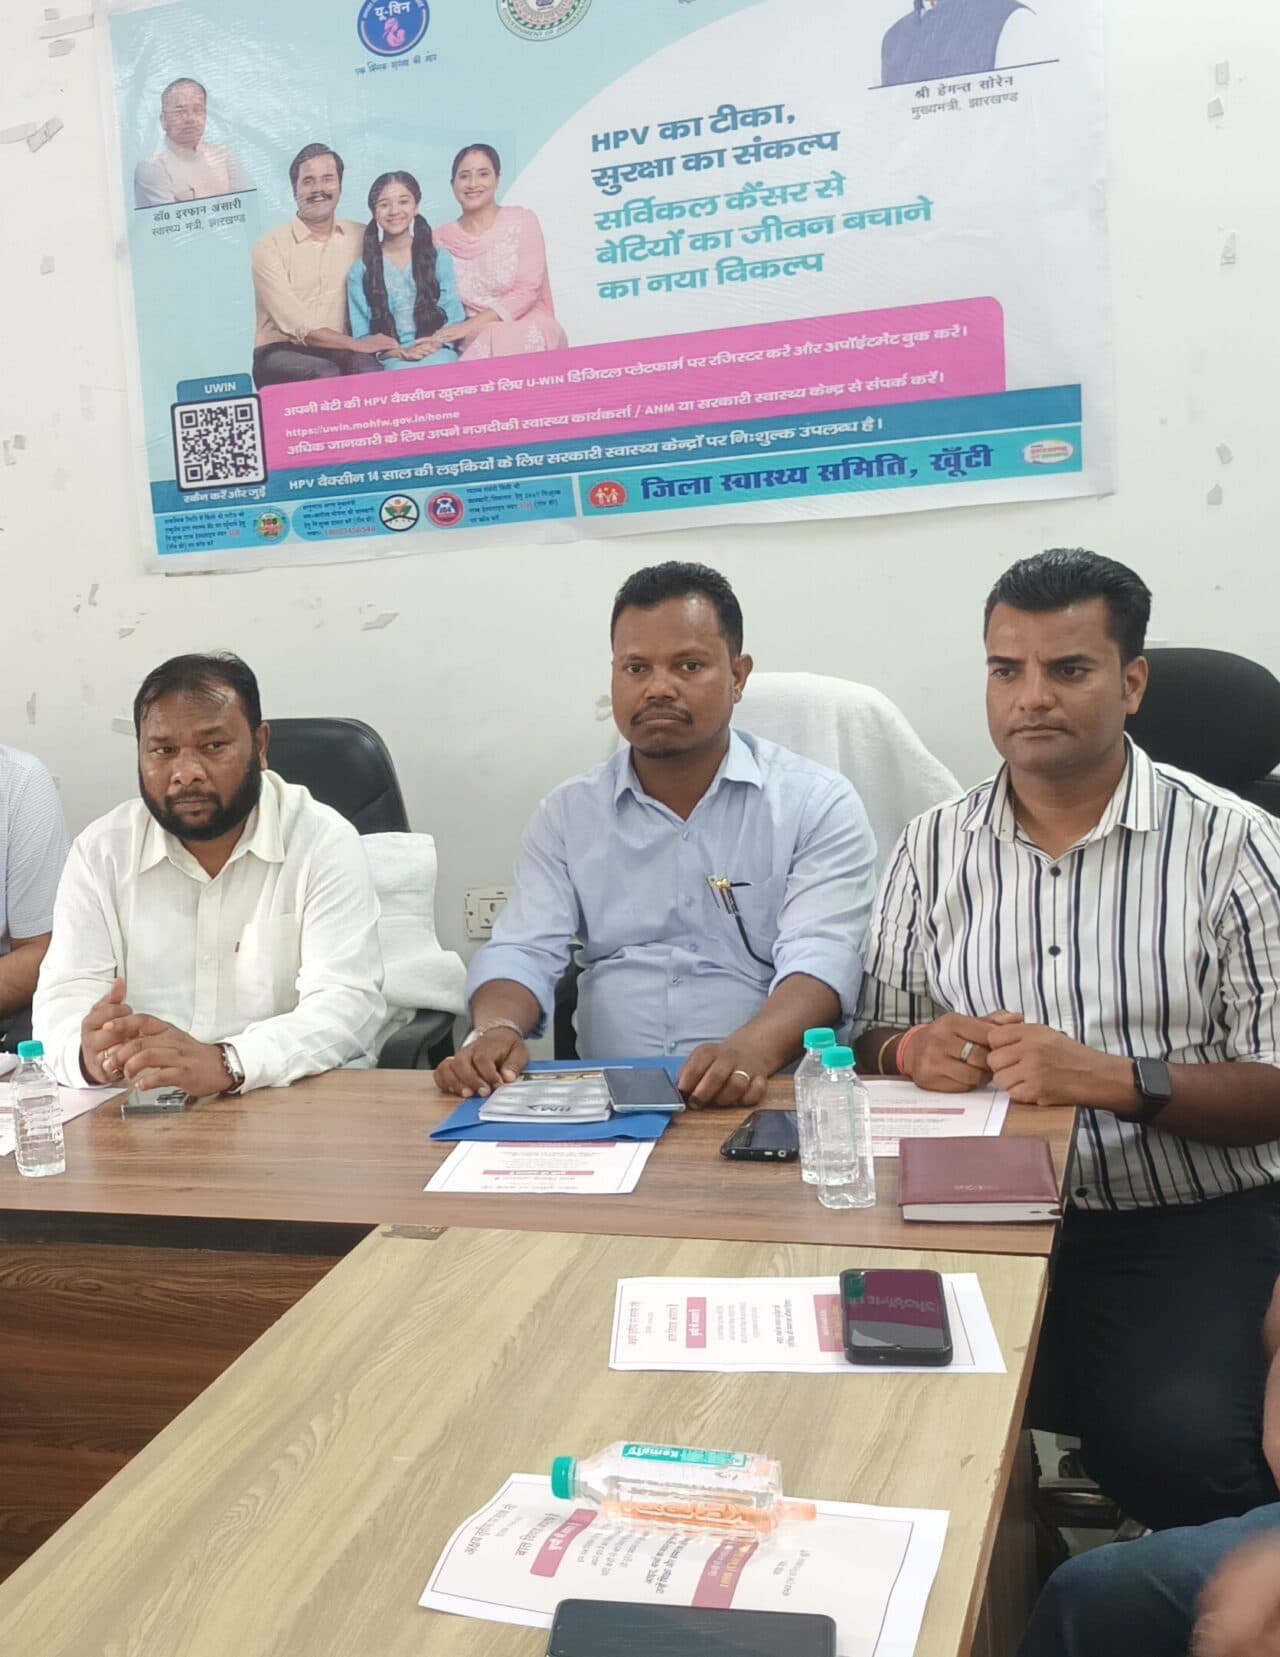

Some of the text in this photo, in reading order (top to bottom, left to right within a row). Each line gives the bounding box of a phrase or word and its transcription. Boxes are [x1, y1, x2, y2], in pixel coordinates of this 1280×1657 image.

[375, 1, 411, 21] यू-विन
[915, 75, 1013, 99] श्री हेमन्त सोरेन
[592, 103, 796, 152] HPV का टीका,
[591, 131, 840, 196] सुरक्षा का संकल्प
[594, 170, 846, 231] सर्विकल कैंसर से
[596, 195, 933, 265] बेटियों का जीवन बचाने
[597, 253, 824, 299] का नया विकल्प
[204, 382, 236, 395] UWIN
[284, 401, 318, 417] अपनी
[344, 396, 361, 409] की
[364, 396, 387, 407] HPV
[480, 378, 494, 393] के
[498, 379, 523, 391] लिए
[526, 375, 564, 388] U-WIN
[567, 367, 620, 383] डिजिटल
[687, 357, 706, 369] पर
[793, 341, 821, 356] और
[902, 330, 930, 348] बुक
[285, 410, 461, 439] https://uwin.mohfw.gov.in/home
[287, 441, 324, 456] अधिक
[327, 433, 382, 450] जानकारी
[384, 431, 398, 444] के
[401, 430, 425, 443] लिए
[428, 425, 460, 440] अपने
[522, 415, 568, 431] स्वास्थ्य
[645, 403, 675, 416] ANM
[678, 400, 694, 412] या
[697, 391, 751, 410] सरकारी
[754, 387, 807, 403] स्वास्थ्य
[847, 378, 863, 393] से
[865, 373, 908, 391] संपर्क
[288, 478, 314, 490] HPV
[367, 471, 379, 482] 14
[381, 467, 412, 480] साल
[414, 463, 433, 477] की
[497, 455, 513, 469] के
[516, 453, 544, 468] लिए
[547, 446, 601, 465] सरकारी
[605, 440, 659, 458] स्वास्थ्य
[705, 435, 726, 447] पर
[798, 420, 858, 437] उपलब्ध
[641, 473, 712, 501] जिला
[721, 465, 809, 492] स्वास्थ्य
[817, 453, 919, 482] समिति,
